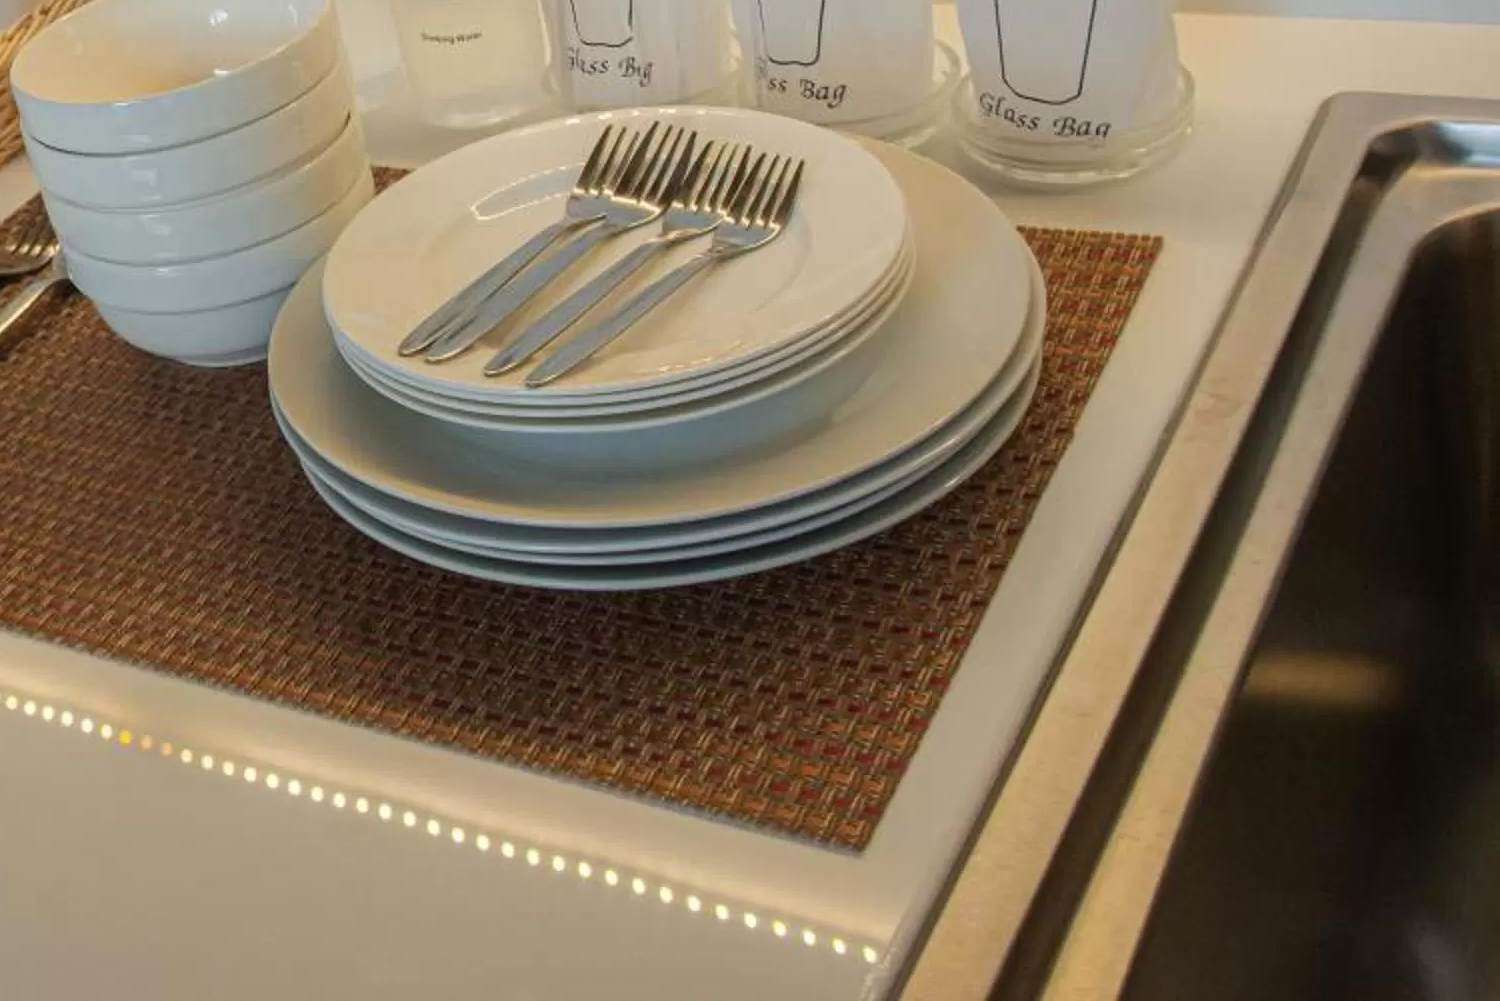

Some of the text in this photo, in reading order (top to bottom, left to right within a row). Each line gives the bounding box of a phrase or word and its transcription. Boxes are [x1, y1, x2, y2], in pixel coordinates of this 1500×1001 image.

[799, 78, 848, 110] Bag
[979, 91, 1112, 139] Glass Bag
